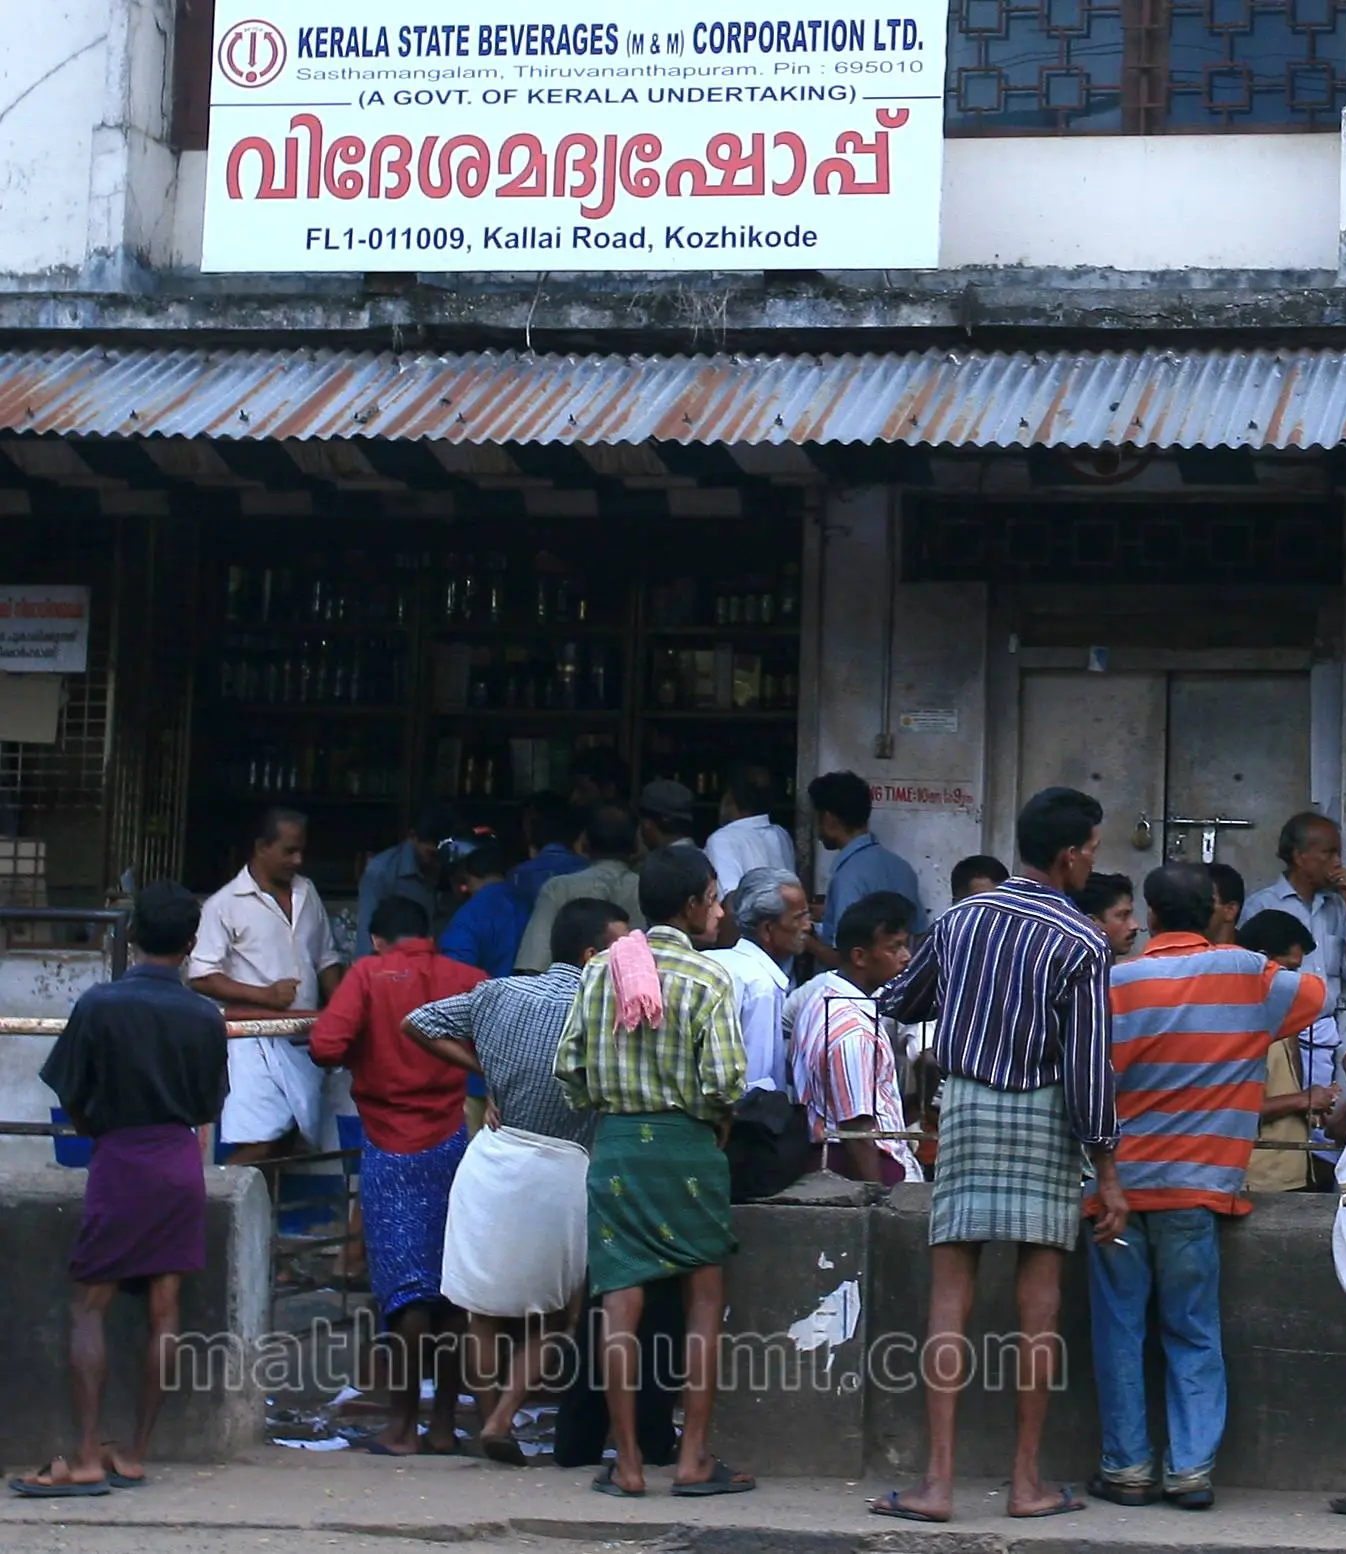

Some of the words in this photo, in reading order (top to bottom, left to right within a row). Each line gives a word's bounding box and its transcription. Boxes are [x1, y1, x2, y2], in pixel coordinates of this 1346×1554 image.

[298, 26, 390, 59] KERALA
[398, 25, 470, 57] STATE
[478, 22, 618, 56] BEVERAGES
[626, 29, 644, 58] (M
[650, 33, 661, 55] &
[666, 29, 684, 57] M)
[693, 19, 865, 54] CORPORATION
[874, 19, 923, 51] LTD.
[296, 66, 504, 82] Sasthamangalam,
[513, 64, 763, 79] Thiruvananthapuram.
[774, 62, 810, 75] Pin
[835, 60, 923, 74] 695010
[358, 90, 385, 110] (A
[394, 90, 471, 106] GOVT.
[482, 89, 518, 104] OF
[528, 88, 639, 104] KERALA
[648, 85, 856, 105] UNDERTAKING)
[226, 107, 909, 219] വിദേശമദ്യഷോപ്പ്
[306, 227, 471, 254] FL1-011009,
[484, 226, 561, 249] Kallai
[573, 225, 653, 253] Road,
[665, 225, 817, 249] Kozhikode
